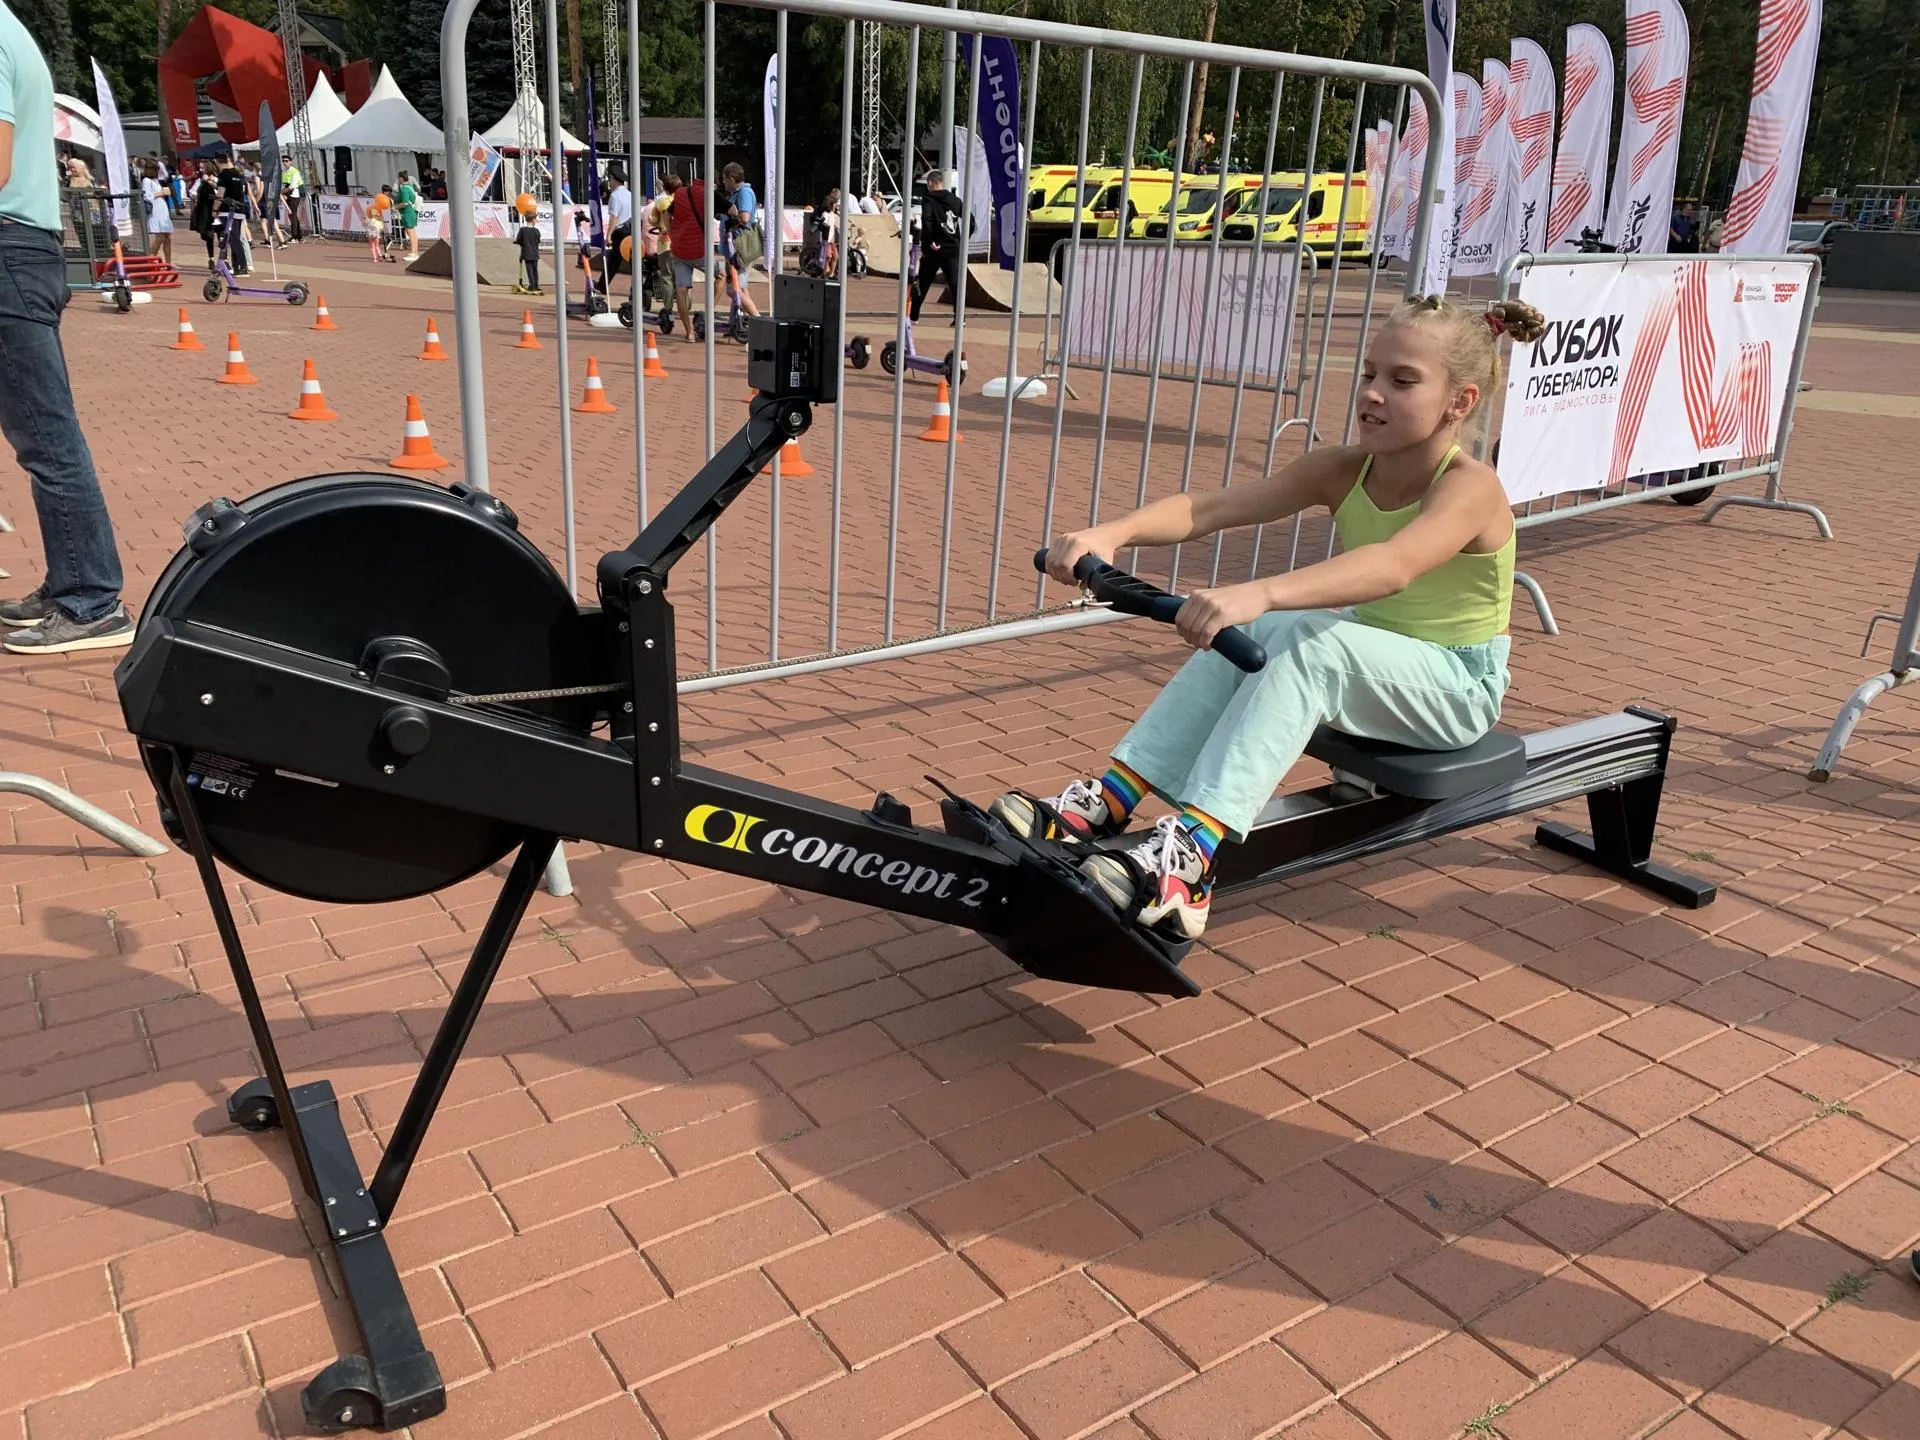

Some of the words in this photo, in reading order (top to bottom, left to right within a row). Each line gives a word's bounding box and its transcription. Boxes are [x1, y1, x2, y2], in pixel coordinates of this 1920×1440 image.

[1529, 313, 1625, 369] КУБОК
[1525, 364, 1619, 401] ГУБЕРНАТОРА
[1523, 403, 1548, 418] ЛИГА
[761, 828, 958, 899] concept
[959, 876, 990, 908] 2
